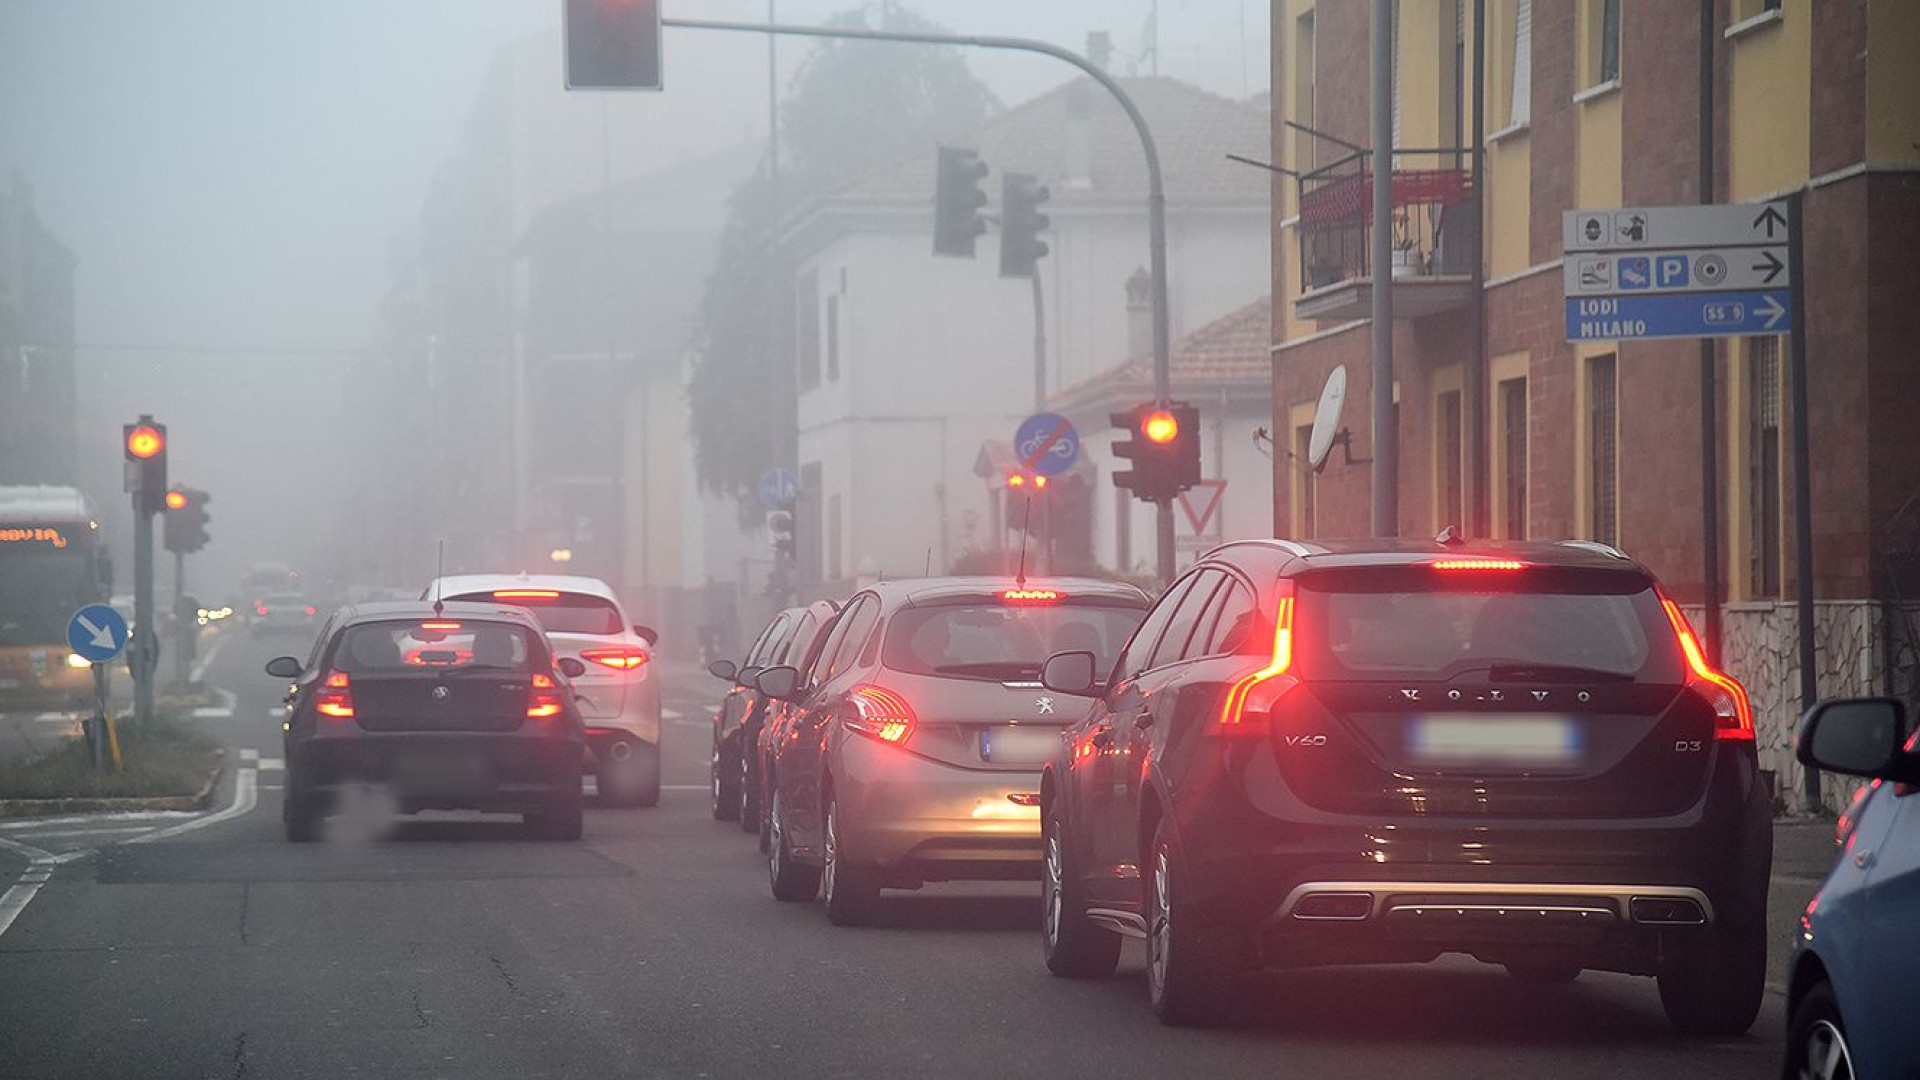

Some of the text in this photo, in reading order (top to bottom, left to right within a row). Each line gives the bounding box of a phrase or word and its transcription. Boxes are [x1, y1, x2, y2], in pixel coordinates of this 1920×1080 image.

[1664, 259, 1683, 284] P
[1580, 299, 1618, 316] LODI
[1708, 305, 1741, 320] SS 9
[1580, 319, 1646, 337] MILANO
[1401, 689, 1591, 702] VOLVO
[1286, 735, 1326, 746] V60
[1675, 741, 1702, 752] D3
